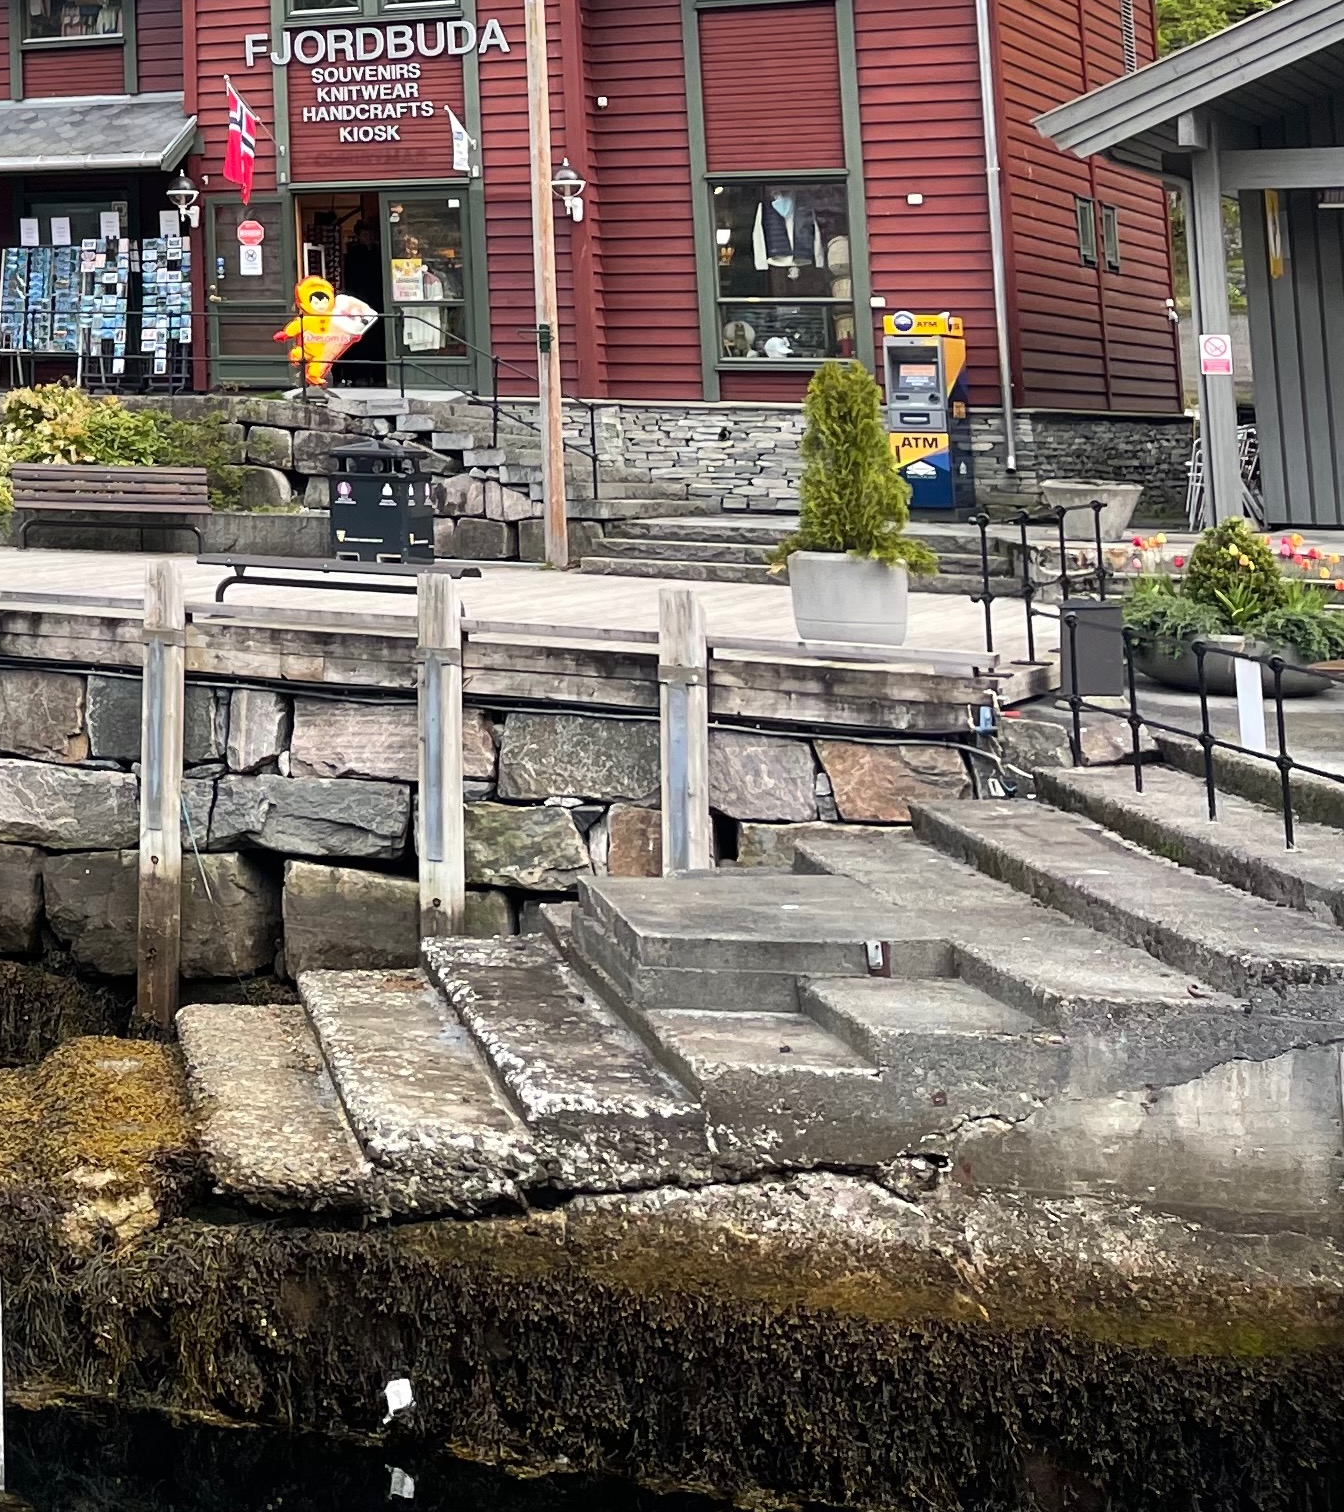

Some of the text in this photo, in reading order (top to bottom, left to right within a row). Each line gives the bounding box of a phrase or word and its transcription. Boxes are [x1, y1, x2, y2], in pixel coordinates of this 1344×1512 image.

[245, 19, 510, 66] FJORDBUDA
[311, 63, 421, 85] SOUVENIRS
[316, 82, 419, 103] KNITWEAR
[302, 101, 434, 123] HANDCRAFTS
[339, 124, 401, 143] KIOSK
[901, 436, 939, 449] ATM
